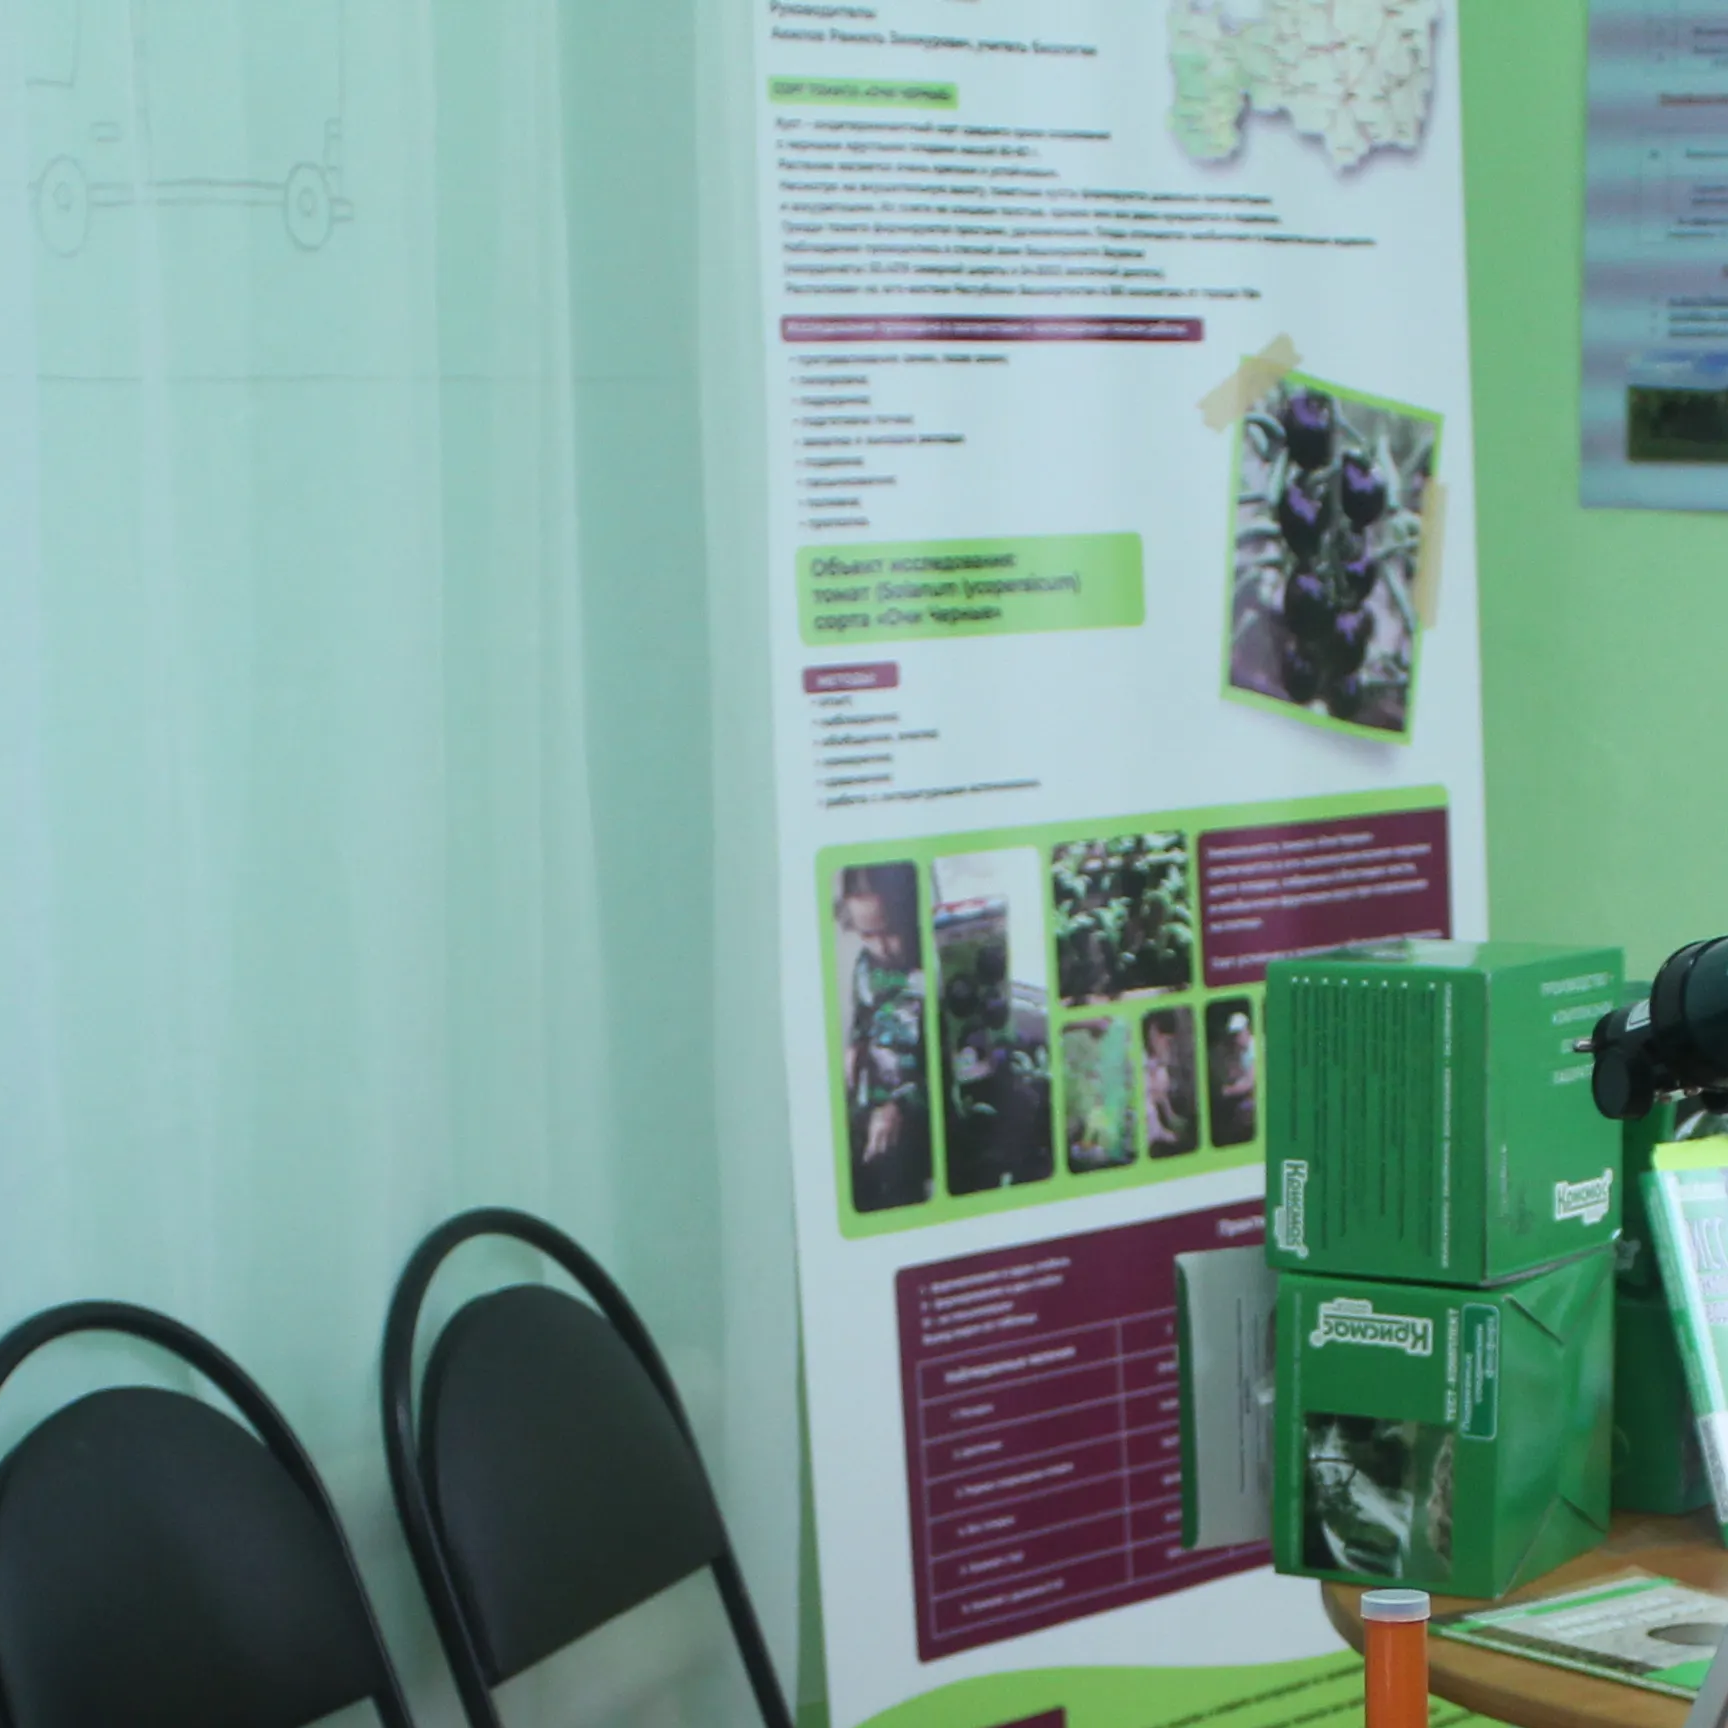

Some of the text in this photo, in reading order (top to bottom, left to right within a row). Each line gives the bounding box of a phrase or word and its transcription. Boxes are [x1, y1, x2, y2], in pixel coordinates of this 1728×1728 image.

[810, 556, 882, 577] Объект
[813, 586, 870, 603] томат
[814, 612, 870, 632] сорта
[1322, 1318, 1430, 1352] Крисмас
